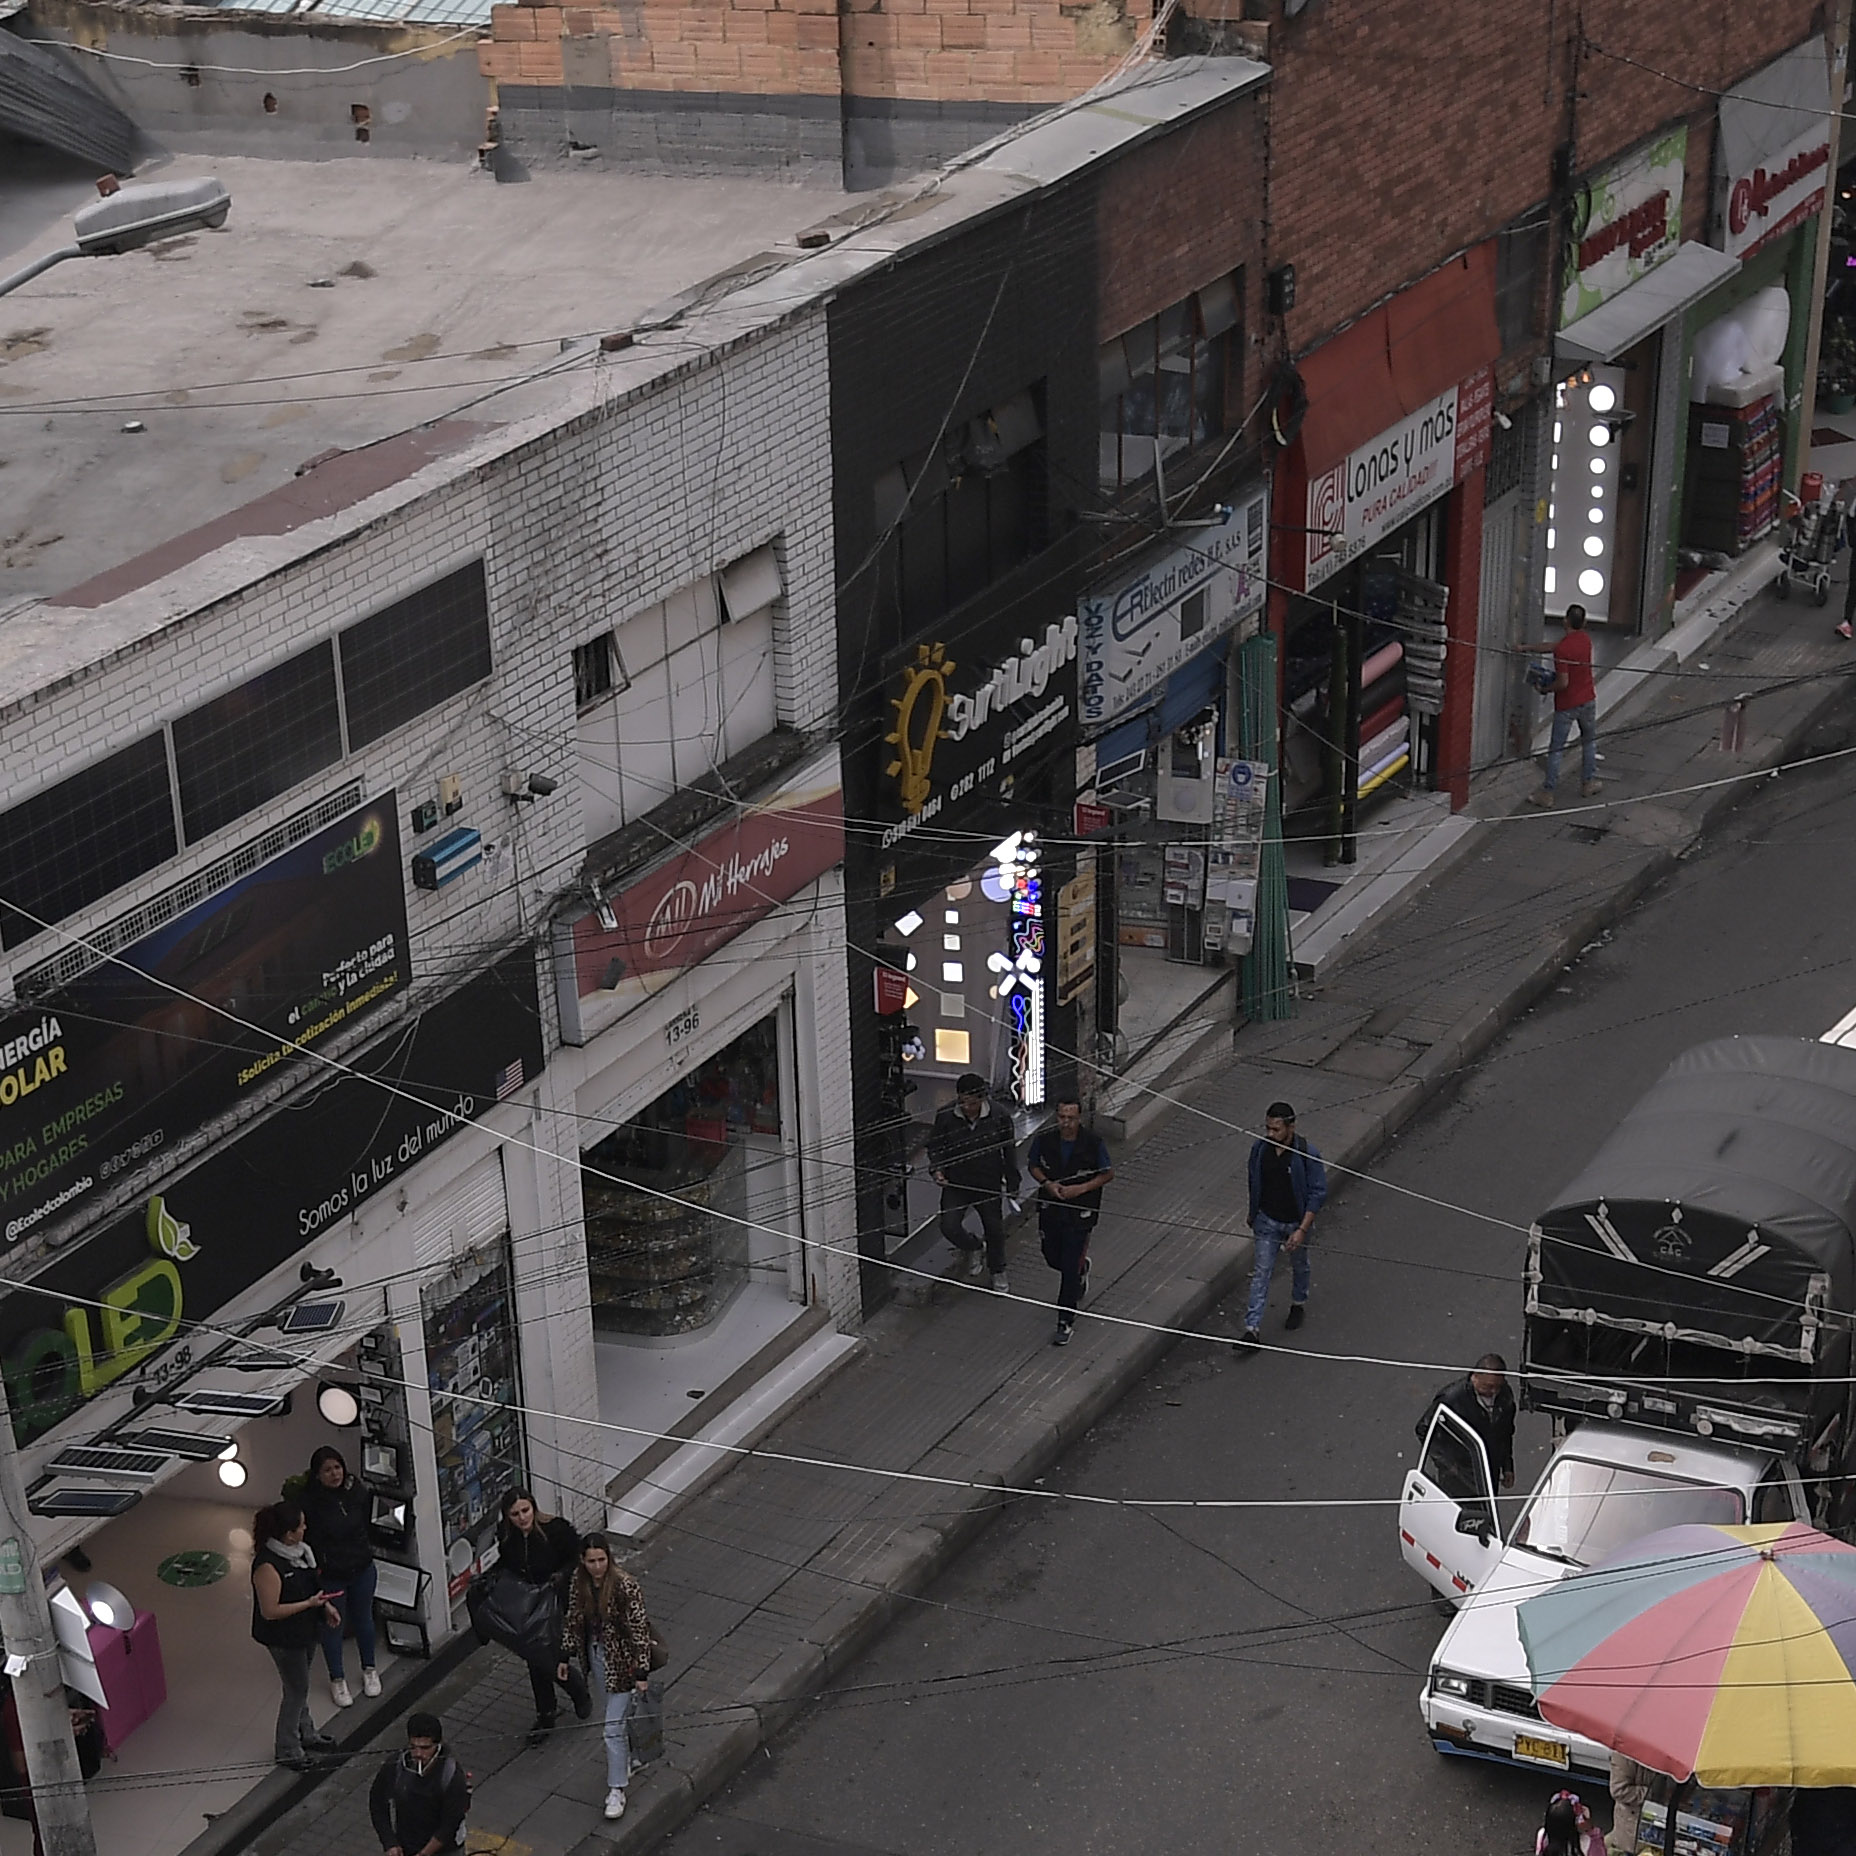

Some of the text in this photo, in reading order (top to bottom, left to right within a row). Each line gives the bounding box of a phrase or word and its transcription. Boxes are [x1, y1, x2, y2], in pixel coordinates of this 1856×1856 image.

[1085, 660, 1104, 719] DATOS
[727, 836, 790, 896] Herrajes
[42, 1081, 125, 1146] EMPRESAS
[12, 1133, 89, 1196] HOGARES
[297, 1094, 475, 1237] Somos la luz del mundo
